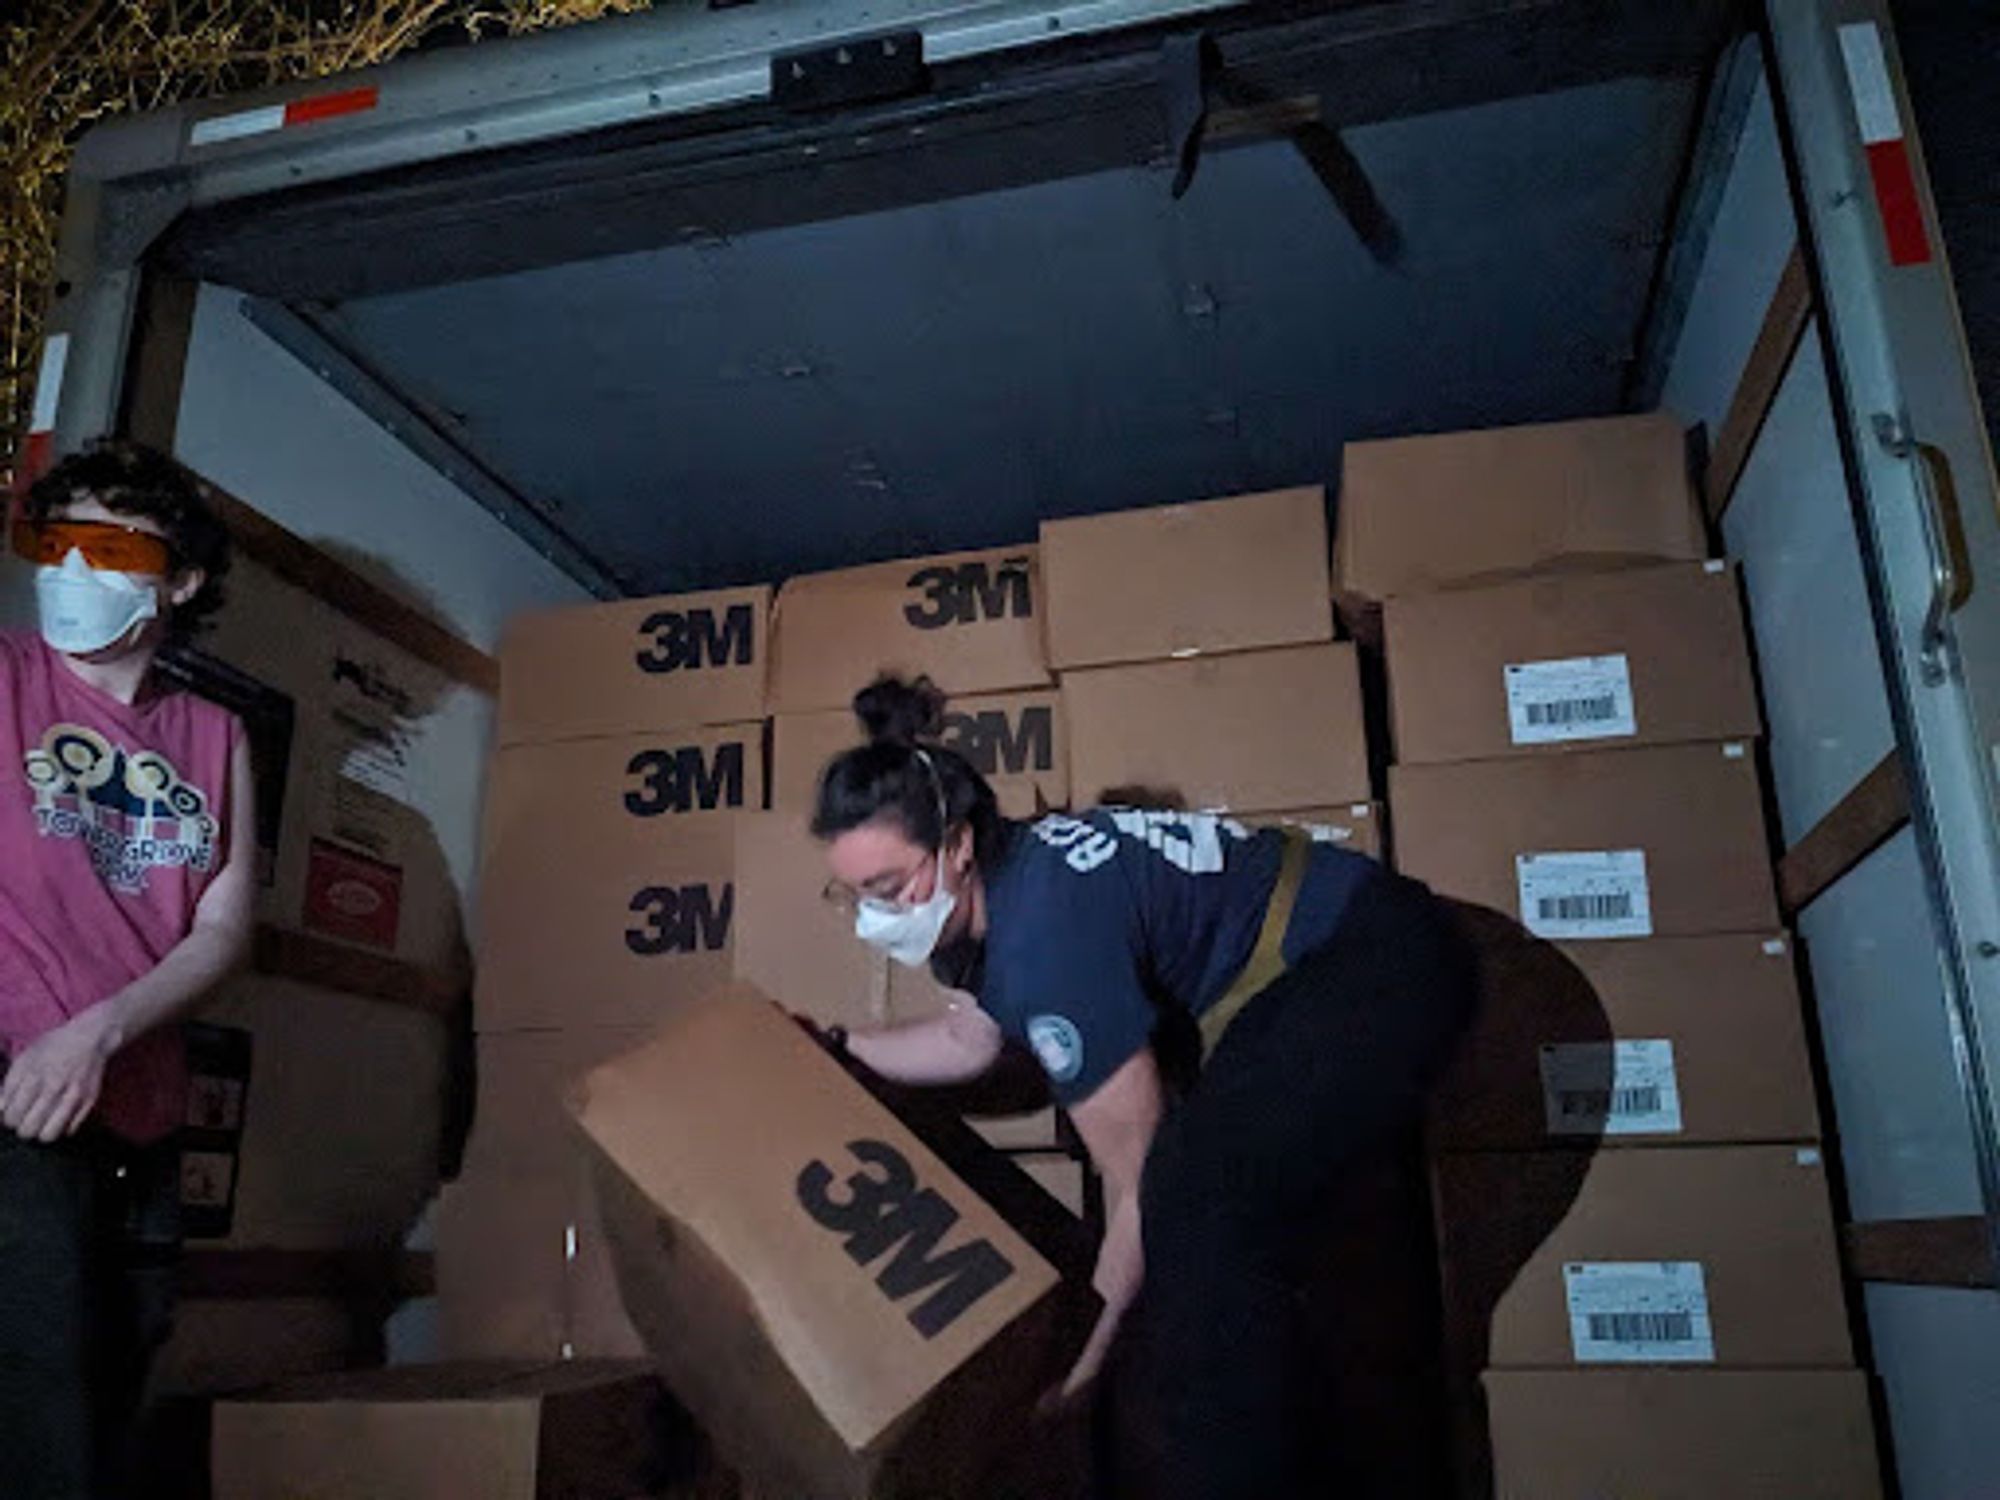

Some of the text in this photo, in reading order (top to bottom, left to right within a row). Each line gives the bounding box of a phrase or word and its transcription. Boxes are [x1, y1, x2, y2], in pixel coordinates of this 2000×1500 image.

[904, 565, 1031, 629] 3M
[637, 605, 753, 673] 3M
[624, 743, 743, 816] 3M
[798, 1139, 1014, 1341] 3M
